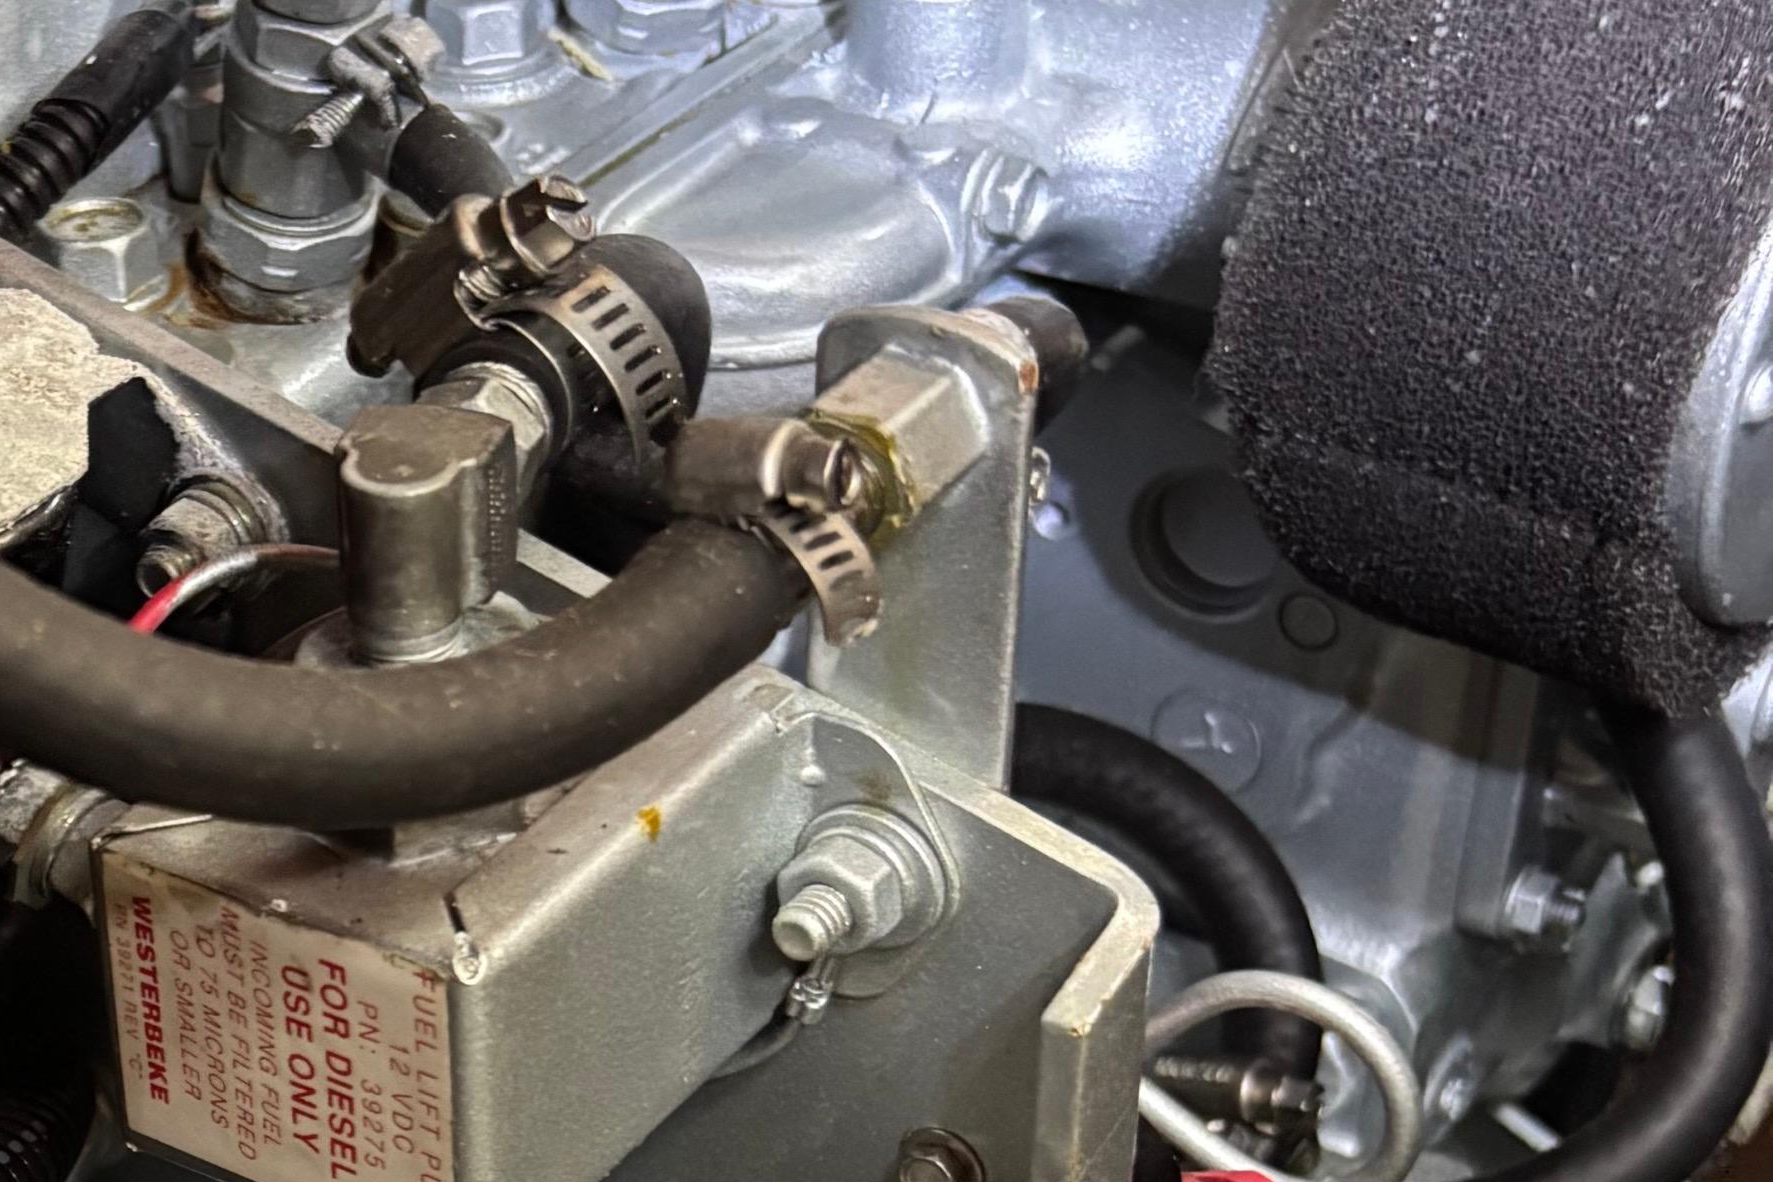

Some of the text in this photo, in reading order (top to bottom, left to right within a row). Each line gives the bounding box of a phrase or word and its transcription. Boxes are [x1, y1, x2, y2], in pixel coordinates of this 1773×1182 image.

[124, 1001, 139, 1040] REV
[132, 896, 170, 1105] WESTERBEKE
[169, 930, 202, 1101] OR SMALLER
[195, 924, 228, 1128] TO 75 MICRONS
[221, 906, 257, 1161] MUST BE FILTERED
[249, 940, 282, 1146] INCOMING FUEL
[281, 965, 320, 1154] USE ONLY
[318, 959, 357, 1179] FOR DIESEL
[357, 1000, 386, 1170] PN: 39275
[412, 969, 438, 1051] FUEL
[389, 1044, 414, 1155] 12 VDC
[417, 1069, 440, 1141] LIFT
